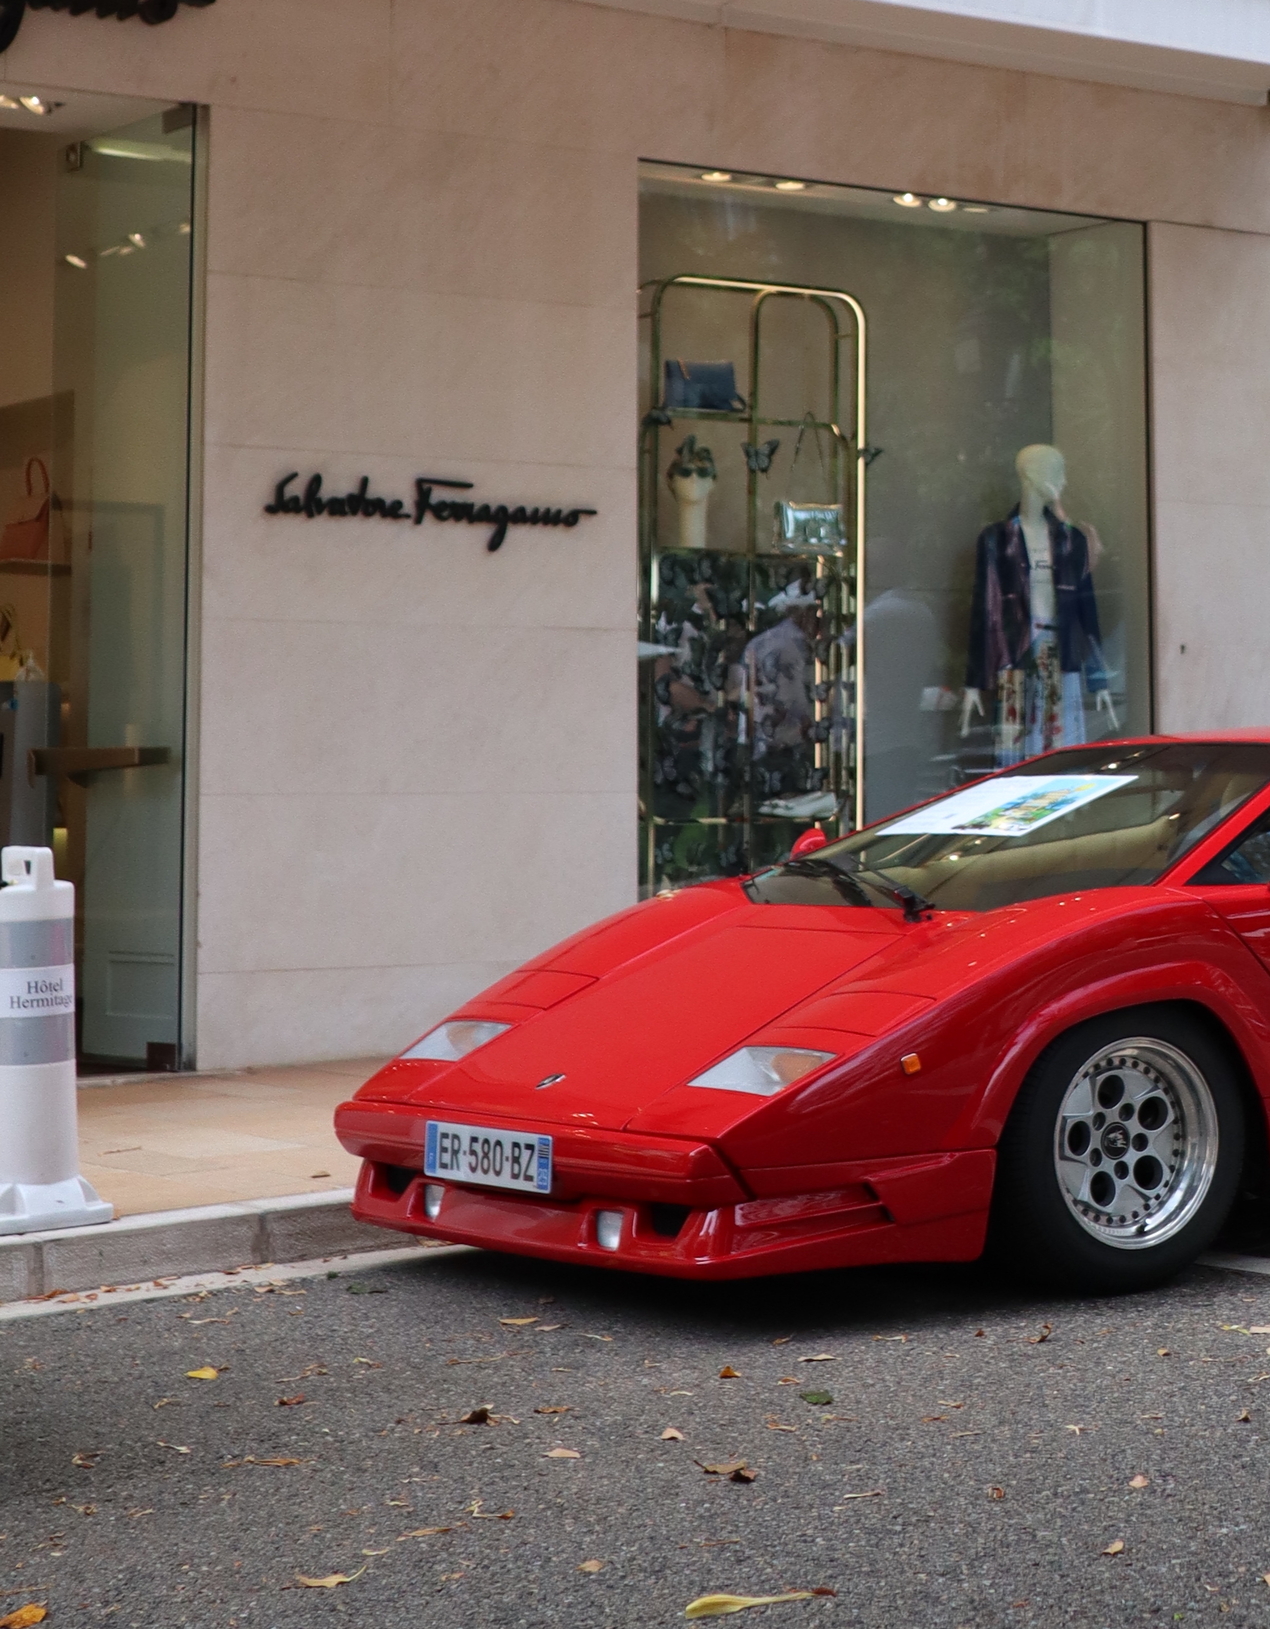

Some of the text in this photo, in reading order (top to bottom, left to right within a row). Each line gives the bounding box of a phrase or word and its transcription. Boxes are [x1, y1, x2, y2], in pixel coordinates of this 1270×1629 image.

[264, 472, 597, 552] Salvatore Ferragamo
[10, 995, 73, 1009] Hermitage
[27, 978, 63, 994] Hôtel
[438, 1132, 536, 1182] ER-580-BZ
